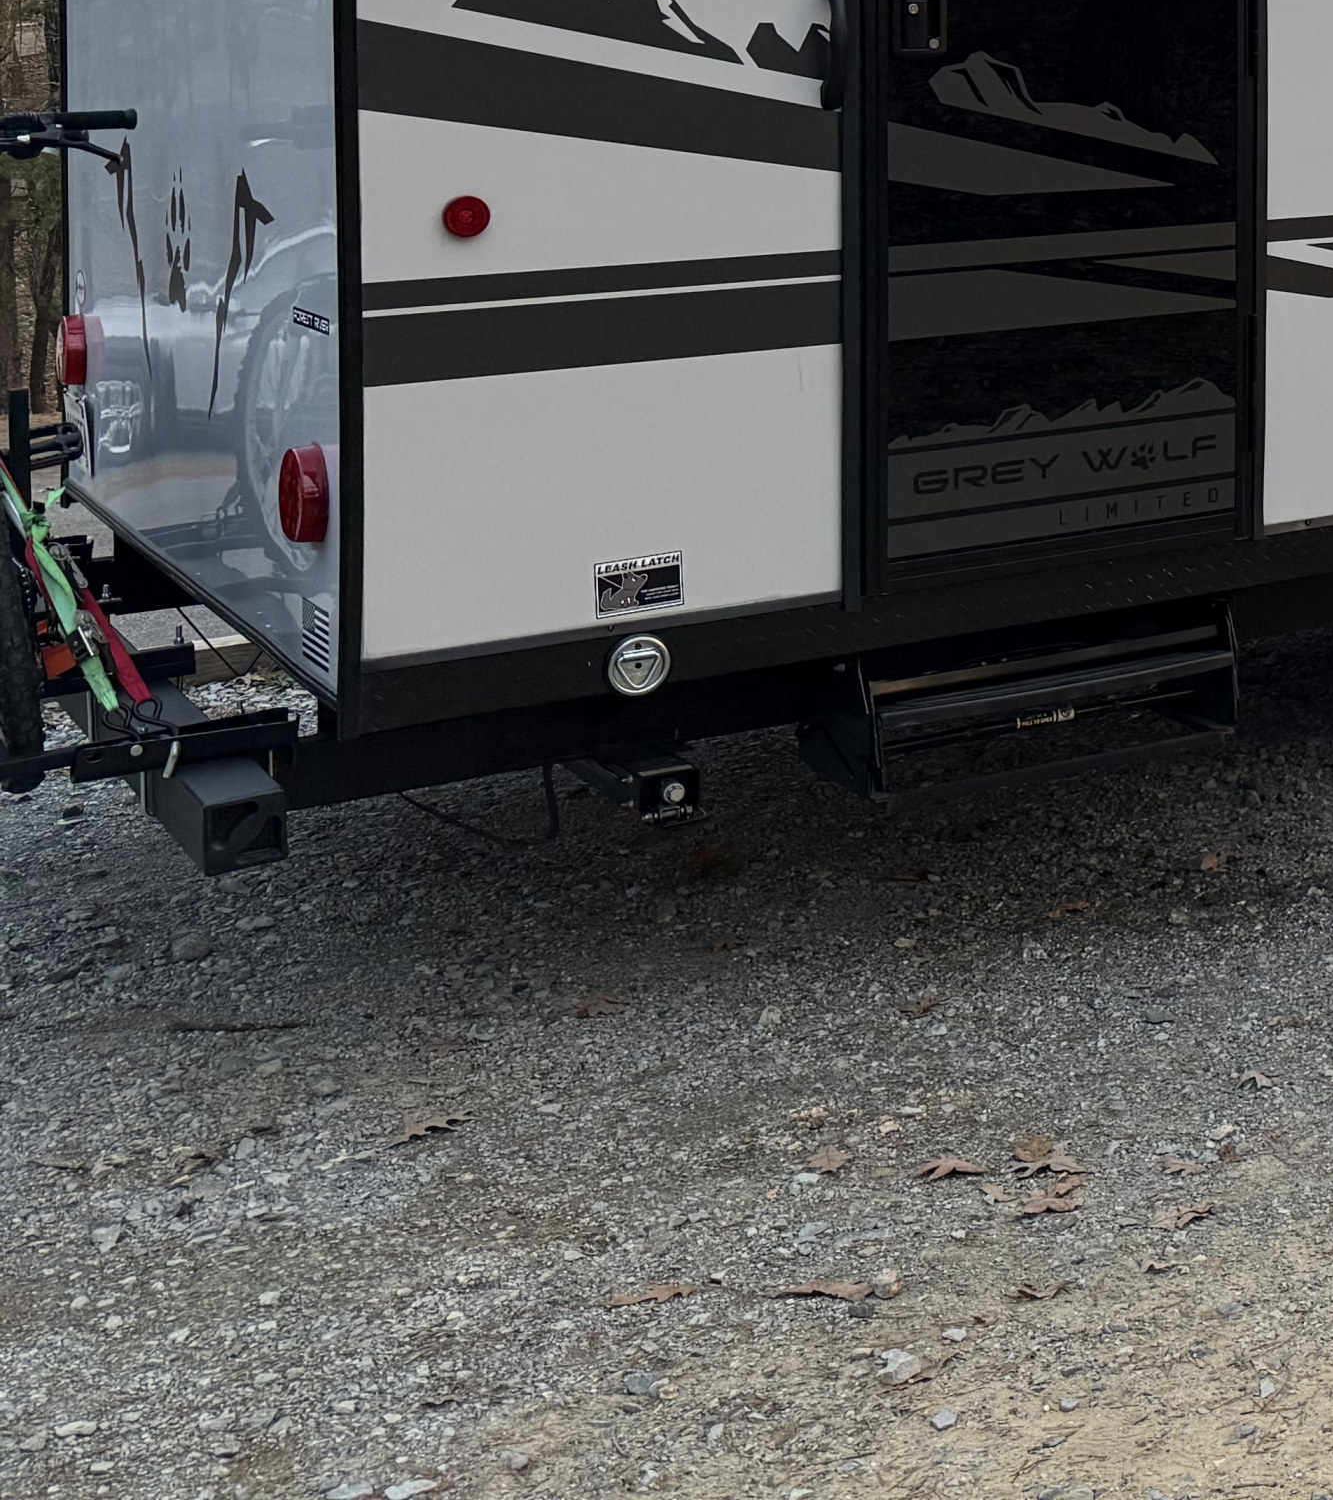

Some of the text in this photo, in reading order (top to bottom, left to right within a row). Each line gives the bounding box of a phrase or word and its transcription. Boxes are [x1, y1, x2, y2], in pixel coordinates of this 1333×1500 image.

[913, 454, 1059, 495] GREY
[1059, 487, 1218, 526] LIMITED
[597, 554, 680, 575] LEASH LATCH
